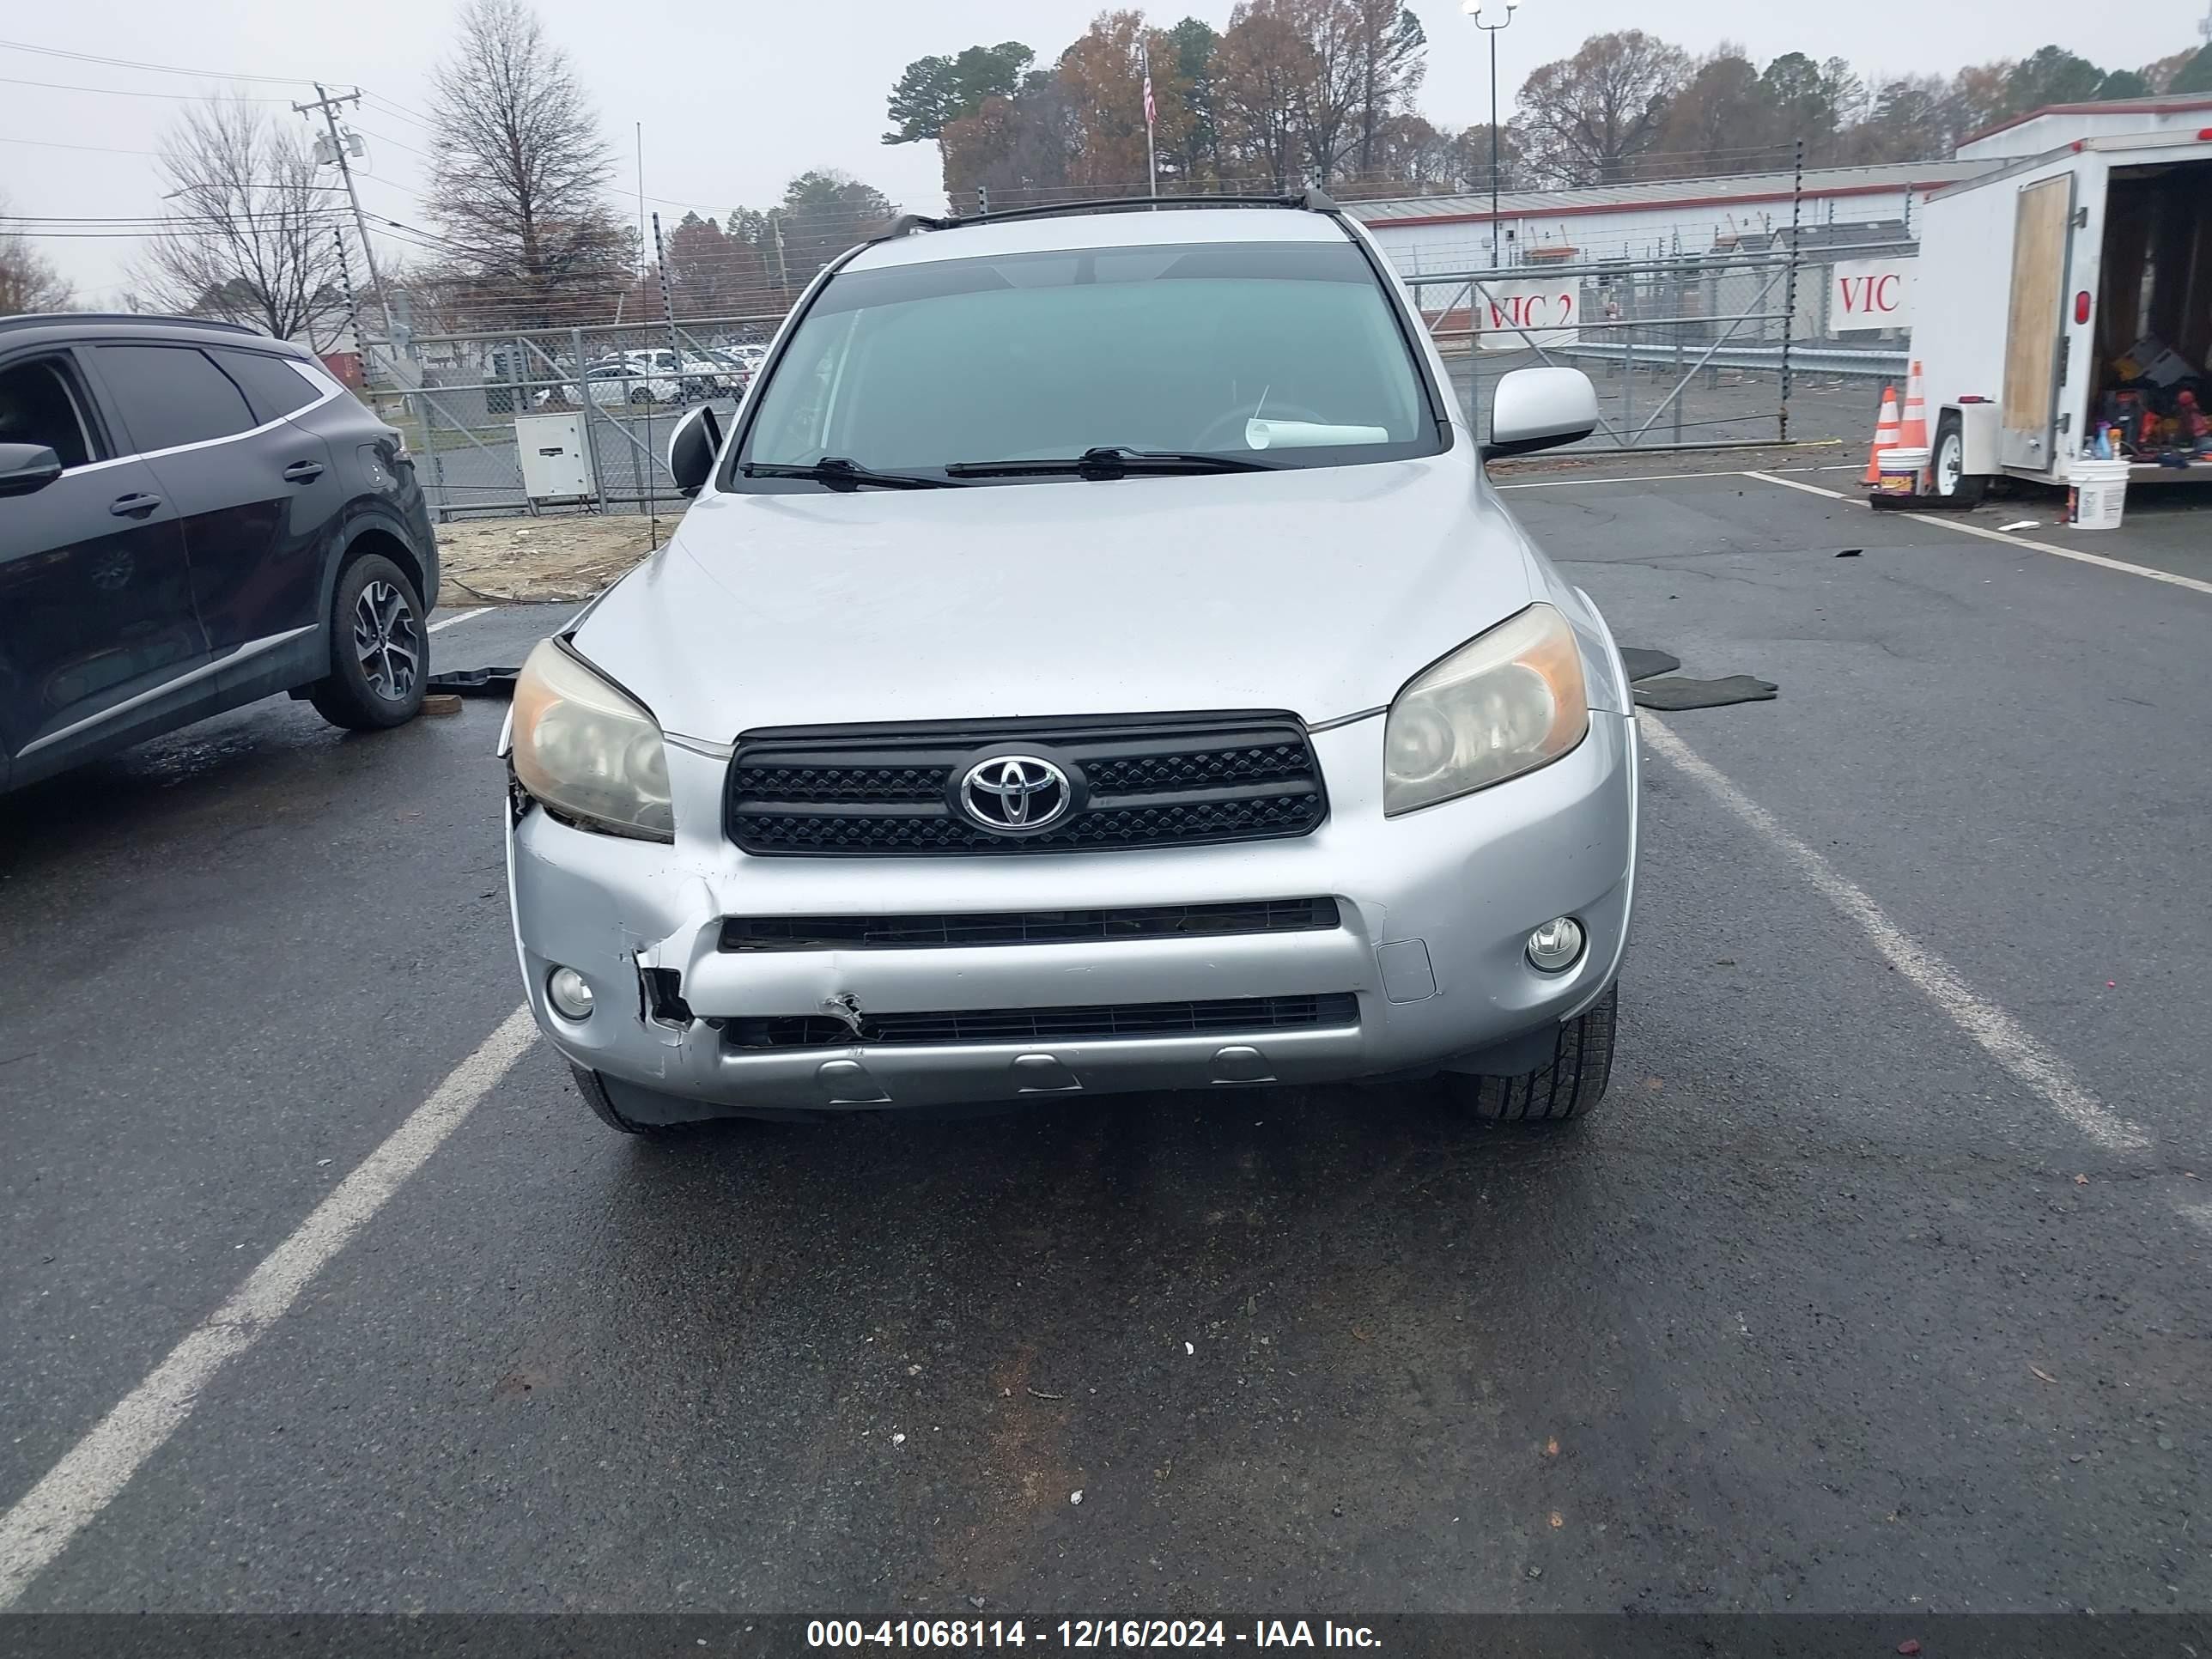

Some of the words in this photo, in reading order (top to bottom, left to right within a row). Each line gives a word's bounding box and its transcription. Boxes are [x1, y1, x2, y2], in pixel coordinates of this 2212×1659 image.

[1490, 295, 1547, 329] VIC
[1559, 294, 1574, 325] 2
[1839, 274, 1900, 313] VIC
